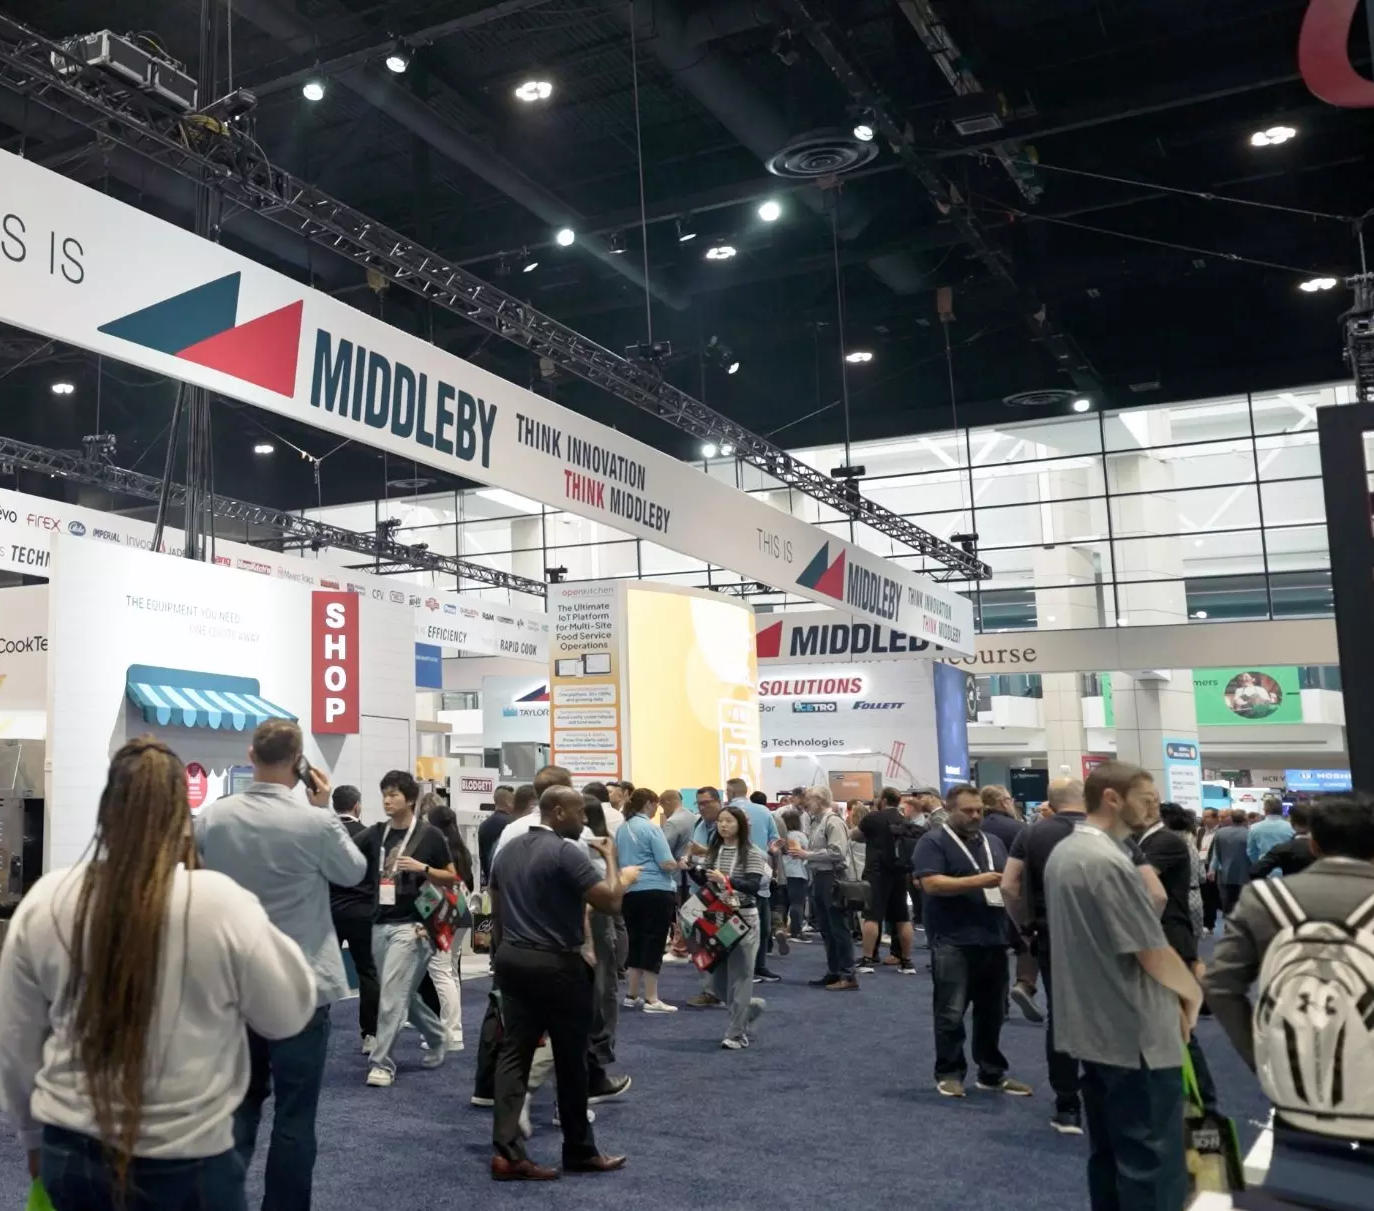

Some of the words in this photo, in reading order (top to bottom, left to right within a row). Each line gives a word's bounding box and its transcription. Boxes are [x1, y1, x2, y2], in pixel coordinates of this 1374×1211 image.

[49, 231, 85, 285] IS
[310, 327, 497, 469] MIDDLEBY
[515, 412, 562, 460] THINK
[567, 434, 647, 489] INNOVATION
[563, 468, 605, 511] THINK
[609, 481, 671, 535] MIDDLEBY
[92, 527, 121, 543] IMPERIAL
[756, 527, 780, 559] THIS
[783, 540, 794, 564] IS
[846, 561, 903, 622] MIDDLEBY
[561, 586, 614, 598] openkitchen
[126, 594, 145, 610] THE
[146, 598, 198, 617] EQUIPMENT
[219, 611, 241, 625] NEED
[557, 604, 573, 612] The
[573, 602, 610, 612] Ultimate
[907, 586, 924, 610] THINK
[924, 592, 953, 622] INNOVATION
[558, 614, 571, 622] IoT
[572, 612, 610, 621] Platform
[427, 625, 468, 644] EFFICIENCY
[555, 624, 568, 632] for
[556, 632, 578, 641] Food
[579, 631, 612, 640] Service
[922, 614, 937, 635] THINK
[938, 622, 962, 645] MIDDLEBY
[500, 639, 519, 653] RAPID
[520, 641, 538, 656] COOK
[560, 642, 608, 651] Operations
[324, 602, 347, 723] SHOP
[758, 677, 863, 697] SOLUTIONS
[519, 708, 550, 717] TAYLOR
[852, 700, 906, 711] FOLLETT
[771, 737, 845, 748] Technologies
[461, 778, 493, 792] BLODGETT
